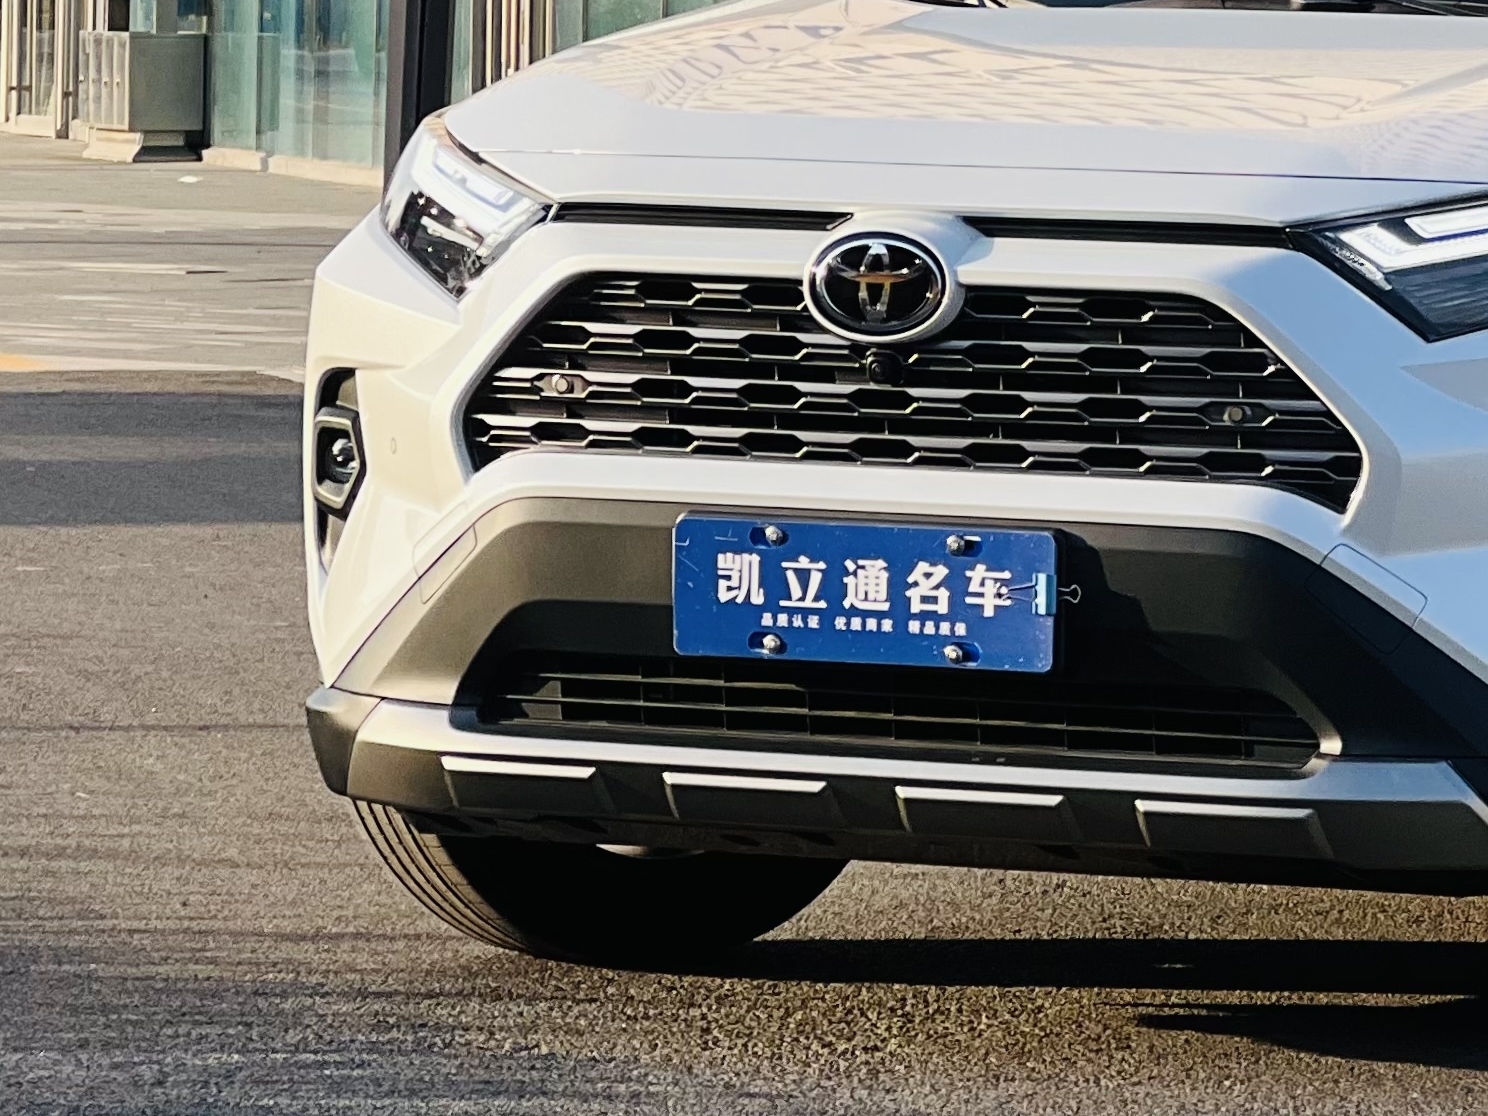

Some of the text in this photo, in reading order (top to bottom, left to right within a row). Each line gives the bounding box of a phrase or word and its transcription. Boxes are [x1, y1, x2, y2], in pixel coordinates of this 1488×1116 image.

[716, 552, 1013, 618] 凯立通名车
[761, 612, 820, 629] 品质认证
